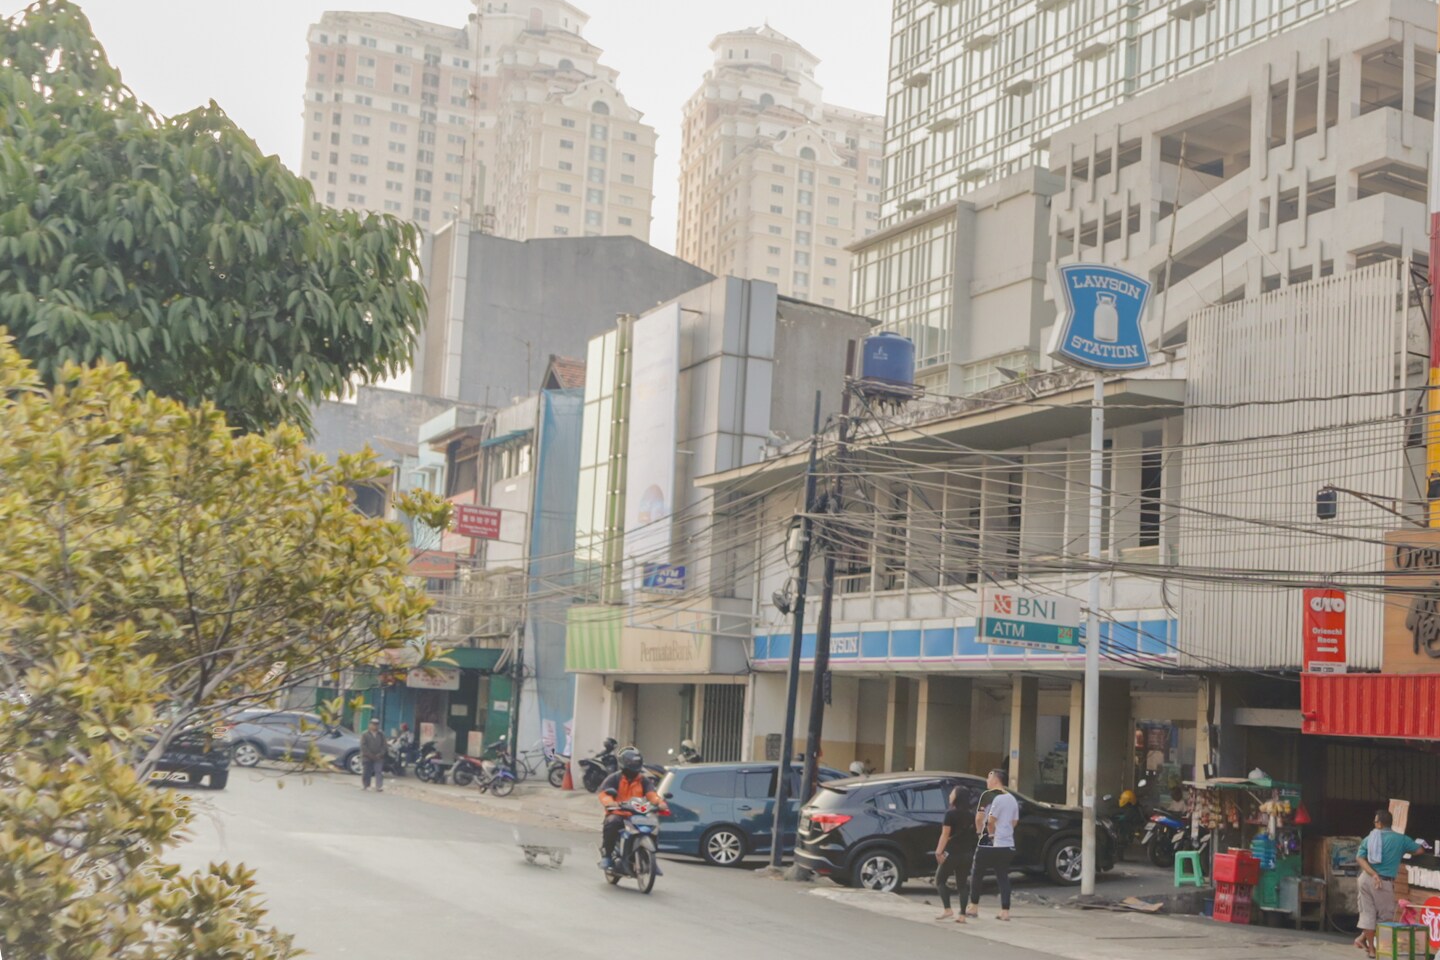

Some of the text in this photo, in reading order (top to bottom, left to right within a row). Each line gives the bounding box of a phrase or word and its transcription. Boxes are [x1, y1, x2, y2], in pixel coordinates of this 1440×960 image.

[1072, 274, 1142, 300] LAWSON
[1070, 334, 1140, 359] STATION
[1017, 597, 1056, 620] BNI
[1310, 596, 1345, 613] OYO
[992, 621, 1025, 638] ATM
[640, 639, 693, 662] PermataBank
